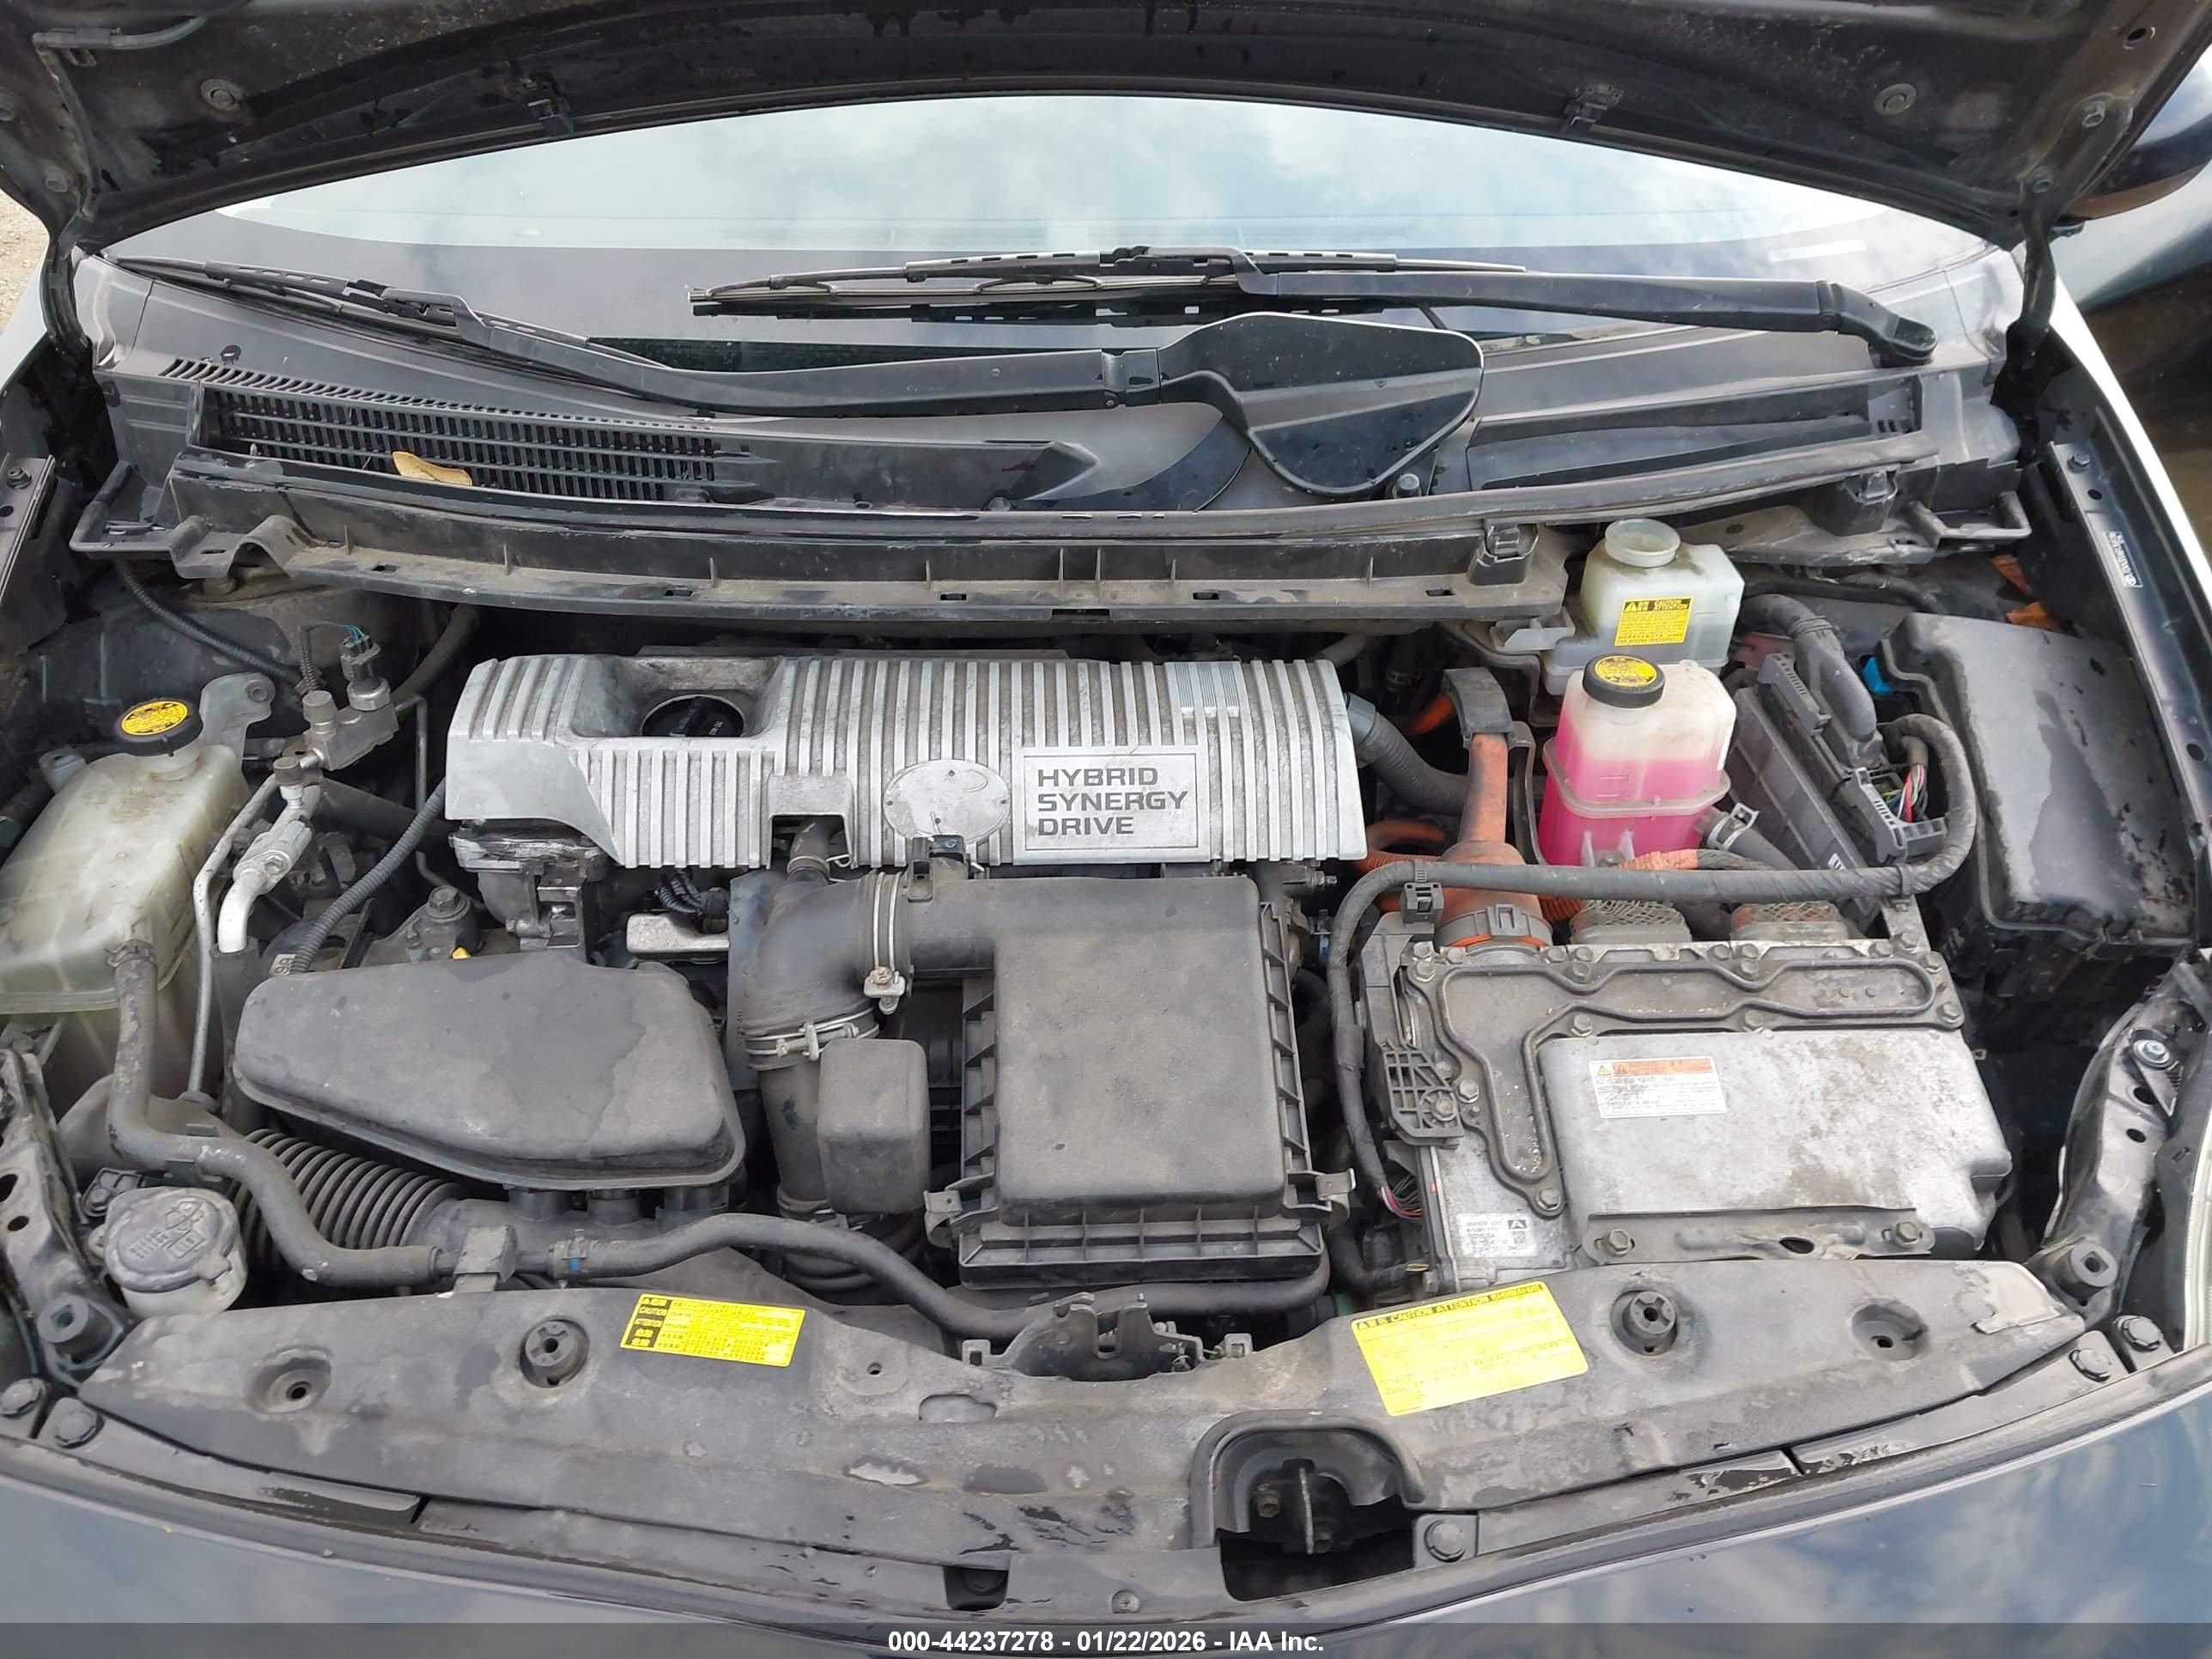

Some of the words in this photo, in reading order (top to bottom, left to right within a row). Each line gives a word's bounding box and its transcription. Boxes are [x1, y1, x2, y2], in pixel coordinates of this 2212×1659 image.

[1037, 767, 1158, 787] HYBRID
[1037, 791, 1188, 812] SYNERGY
[1038, 817, 1134, 836] DRIVE
